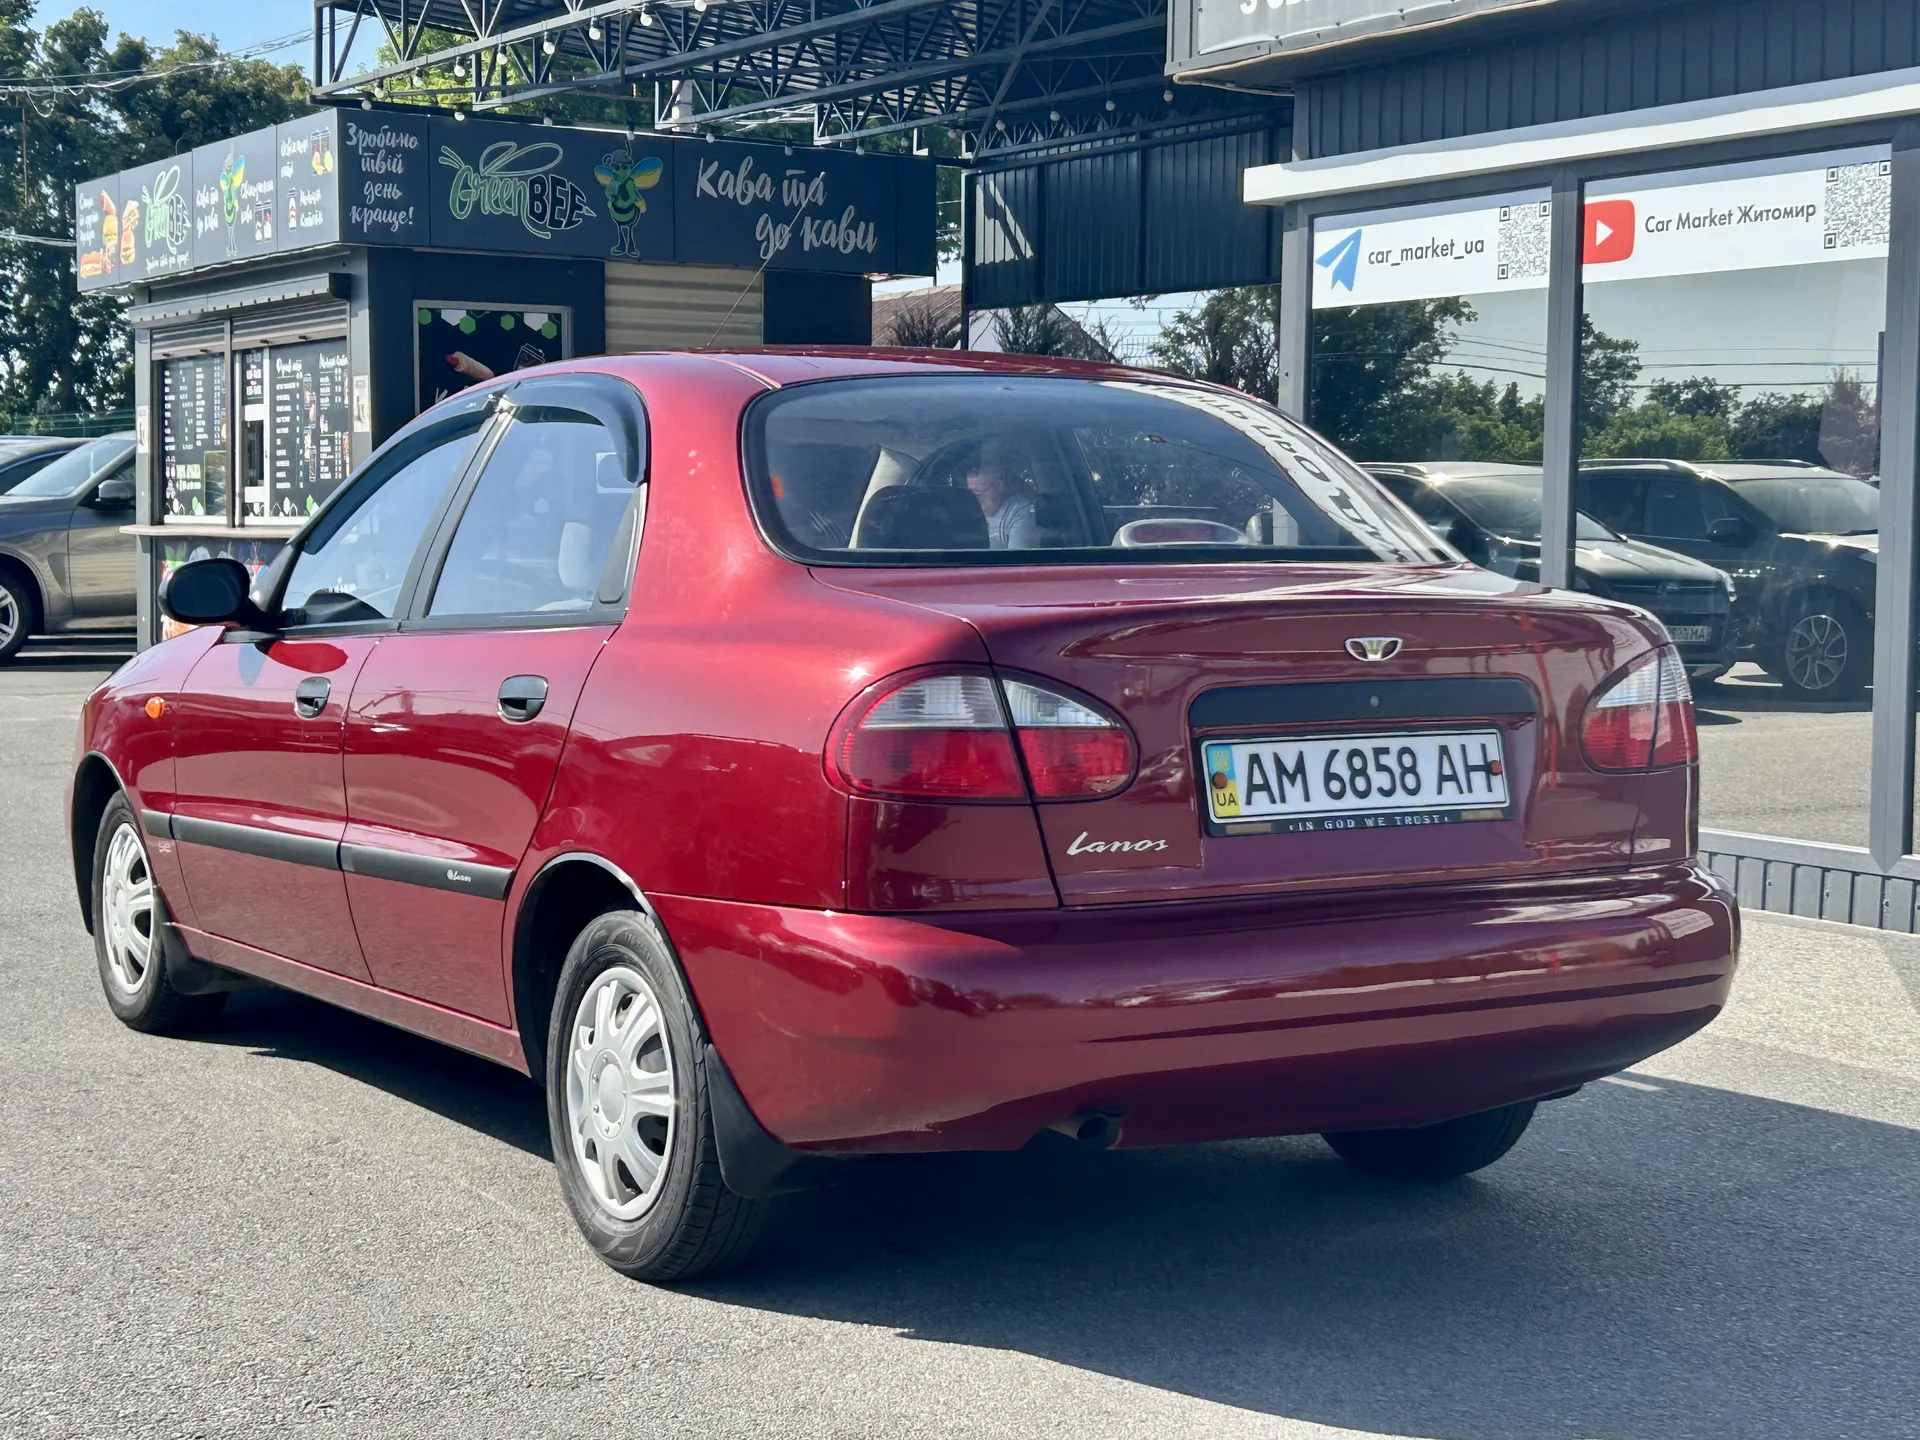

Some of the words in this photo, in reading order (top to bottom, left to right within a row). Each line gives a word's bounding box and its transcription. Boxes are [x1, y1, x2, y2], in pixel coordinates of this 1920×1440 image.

[345, 122, 419, 155] Зробимо
[361, 149, 404, 174] твій
[364, 180, 403, 205] день
[696, 156, 775, 206] Кава
[783, 169, 826, 206] та
[350, 205, 415, 233] краще!
[755, 216, 790, 260] до
[800, 205, 878, 254] кави
[1645, 216, 1672, 233] Car
[1676, 207, 1734, 231] Market
[1737, 203, 1817, 225] Житомир
[1368, 236, 1484, 266] car_market_ua
[1245, 751, 1310, 805] AM
[1323, 746, 1422, 800] 6858
[1436, 743, 1493, 796] AH
[1216, 792, 1237, 807] UA
[1299, 822, 1313, 831] IN
[1324, 819, 1355, 829] GOD
[1365, 817, 1386, 827] WE
[1394, 814, 1440, 825] TRUST
[1066, 832, 1169, 857] Lanos
